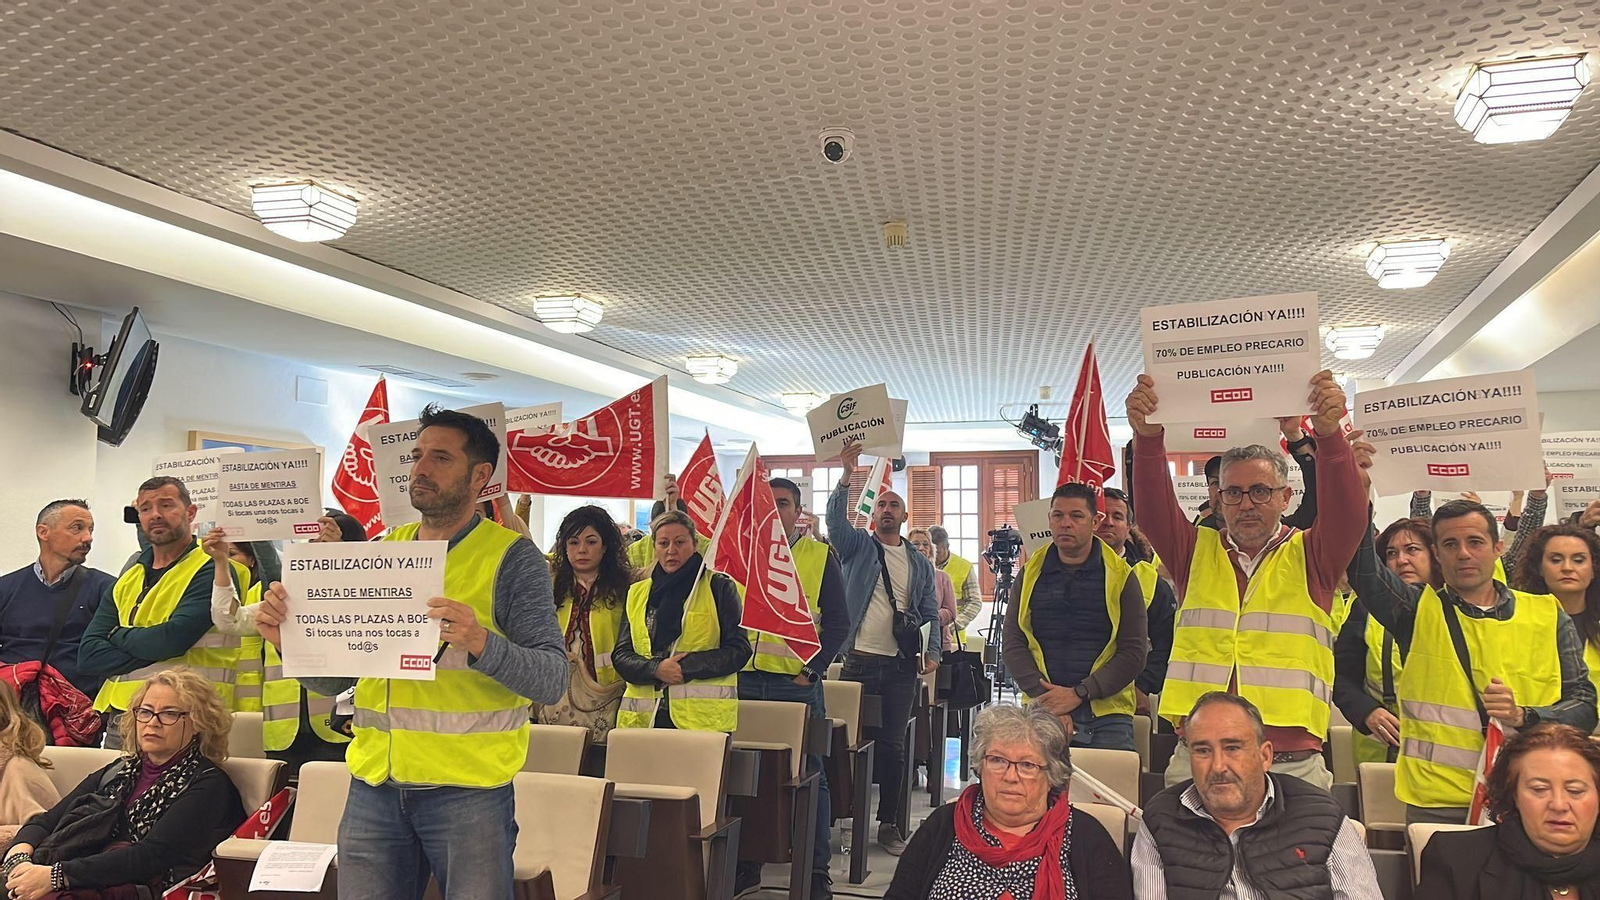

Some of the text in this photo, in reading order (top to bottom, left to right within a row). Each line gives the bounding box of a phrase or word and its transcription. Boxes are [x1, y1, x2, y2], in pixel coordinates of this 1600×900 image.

[1152, 307, 1306, 331] ESTABILIZACIÓN YA!!!!
[1155, 337, 1304, 358] 70% DE EMPLEO PRECARIO
[1177, 363, 1285, 380] PUBLICACIÓN YA!!!!
[1213, 390, 1251, 401] CCOO
[1364, 385, 1522, 413] ESTABILIZACIÓN YA!!!!
[820, 417, 885, 443] PUBLICACIÓN
[1366, 428, 1388, 438] 70%
[1391, 426, 1407, 435] DE
[1409, 421, 1456, 433] EMPLEO
[1459, 415, 1522, 429] PRECARIO
[1196, 430, 1226, 438] CCOO
[1391, 441, 1502, 454] PUBLICACIÓN YA!!!!
[156, 456, 215, 470] ESTABILIZACIÓN
[222, 460, 279, 472] ESTABILIZACIÓN
[281, 459, 308, 469] YA!!!!
[1430, 465, 1468, 475] CCOO
[261, 480, 297, 489] MENTIRAS
[192, 487, 216, 495] PLAZAS
[223, 500, 243, 508] TODAS
[259, 498, 286, 506] PLAZAS
[294, 497, 309, 505] BOE
[256, 517, 278, 525] tod@s
[295, 525, 319, 533] CCOO
[290, 555, 433, 571] ESTABILIZACIÓN YA!!!!
[307, 587, 412, 598] BASTA DE MENTIRAS
[295, 614, 428, 624] TODAS LAS PLAZAS A BOE
[305, 627, 420, 637] Si tocas una nos tocas a
[348, 641, 379, 653] tod@s
[402, 657, 430, 668] CCOO
